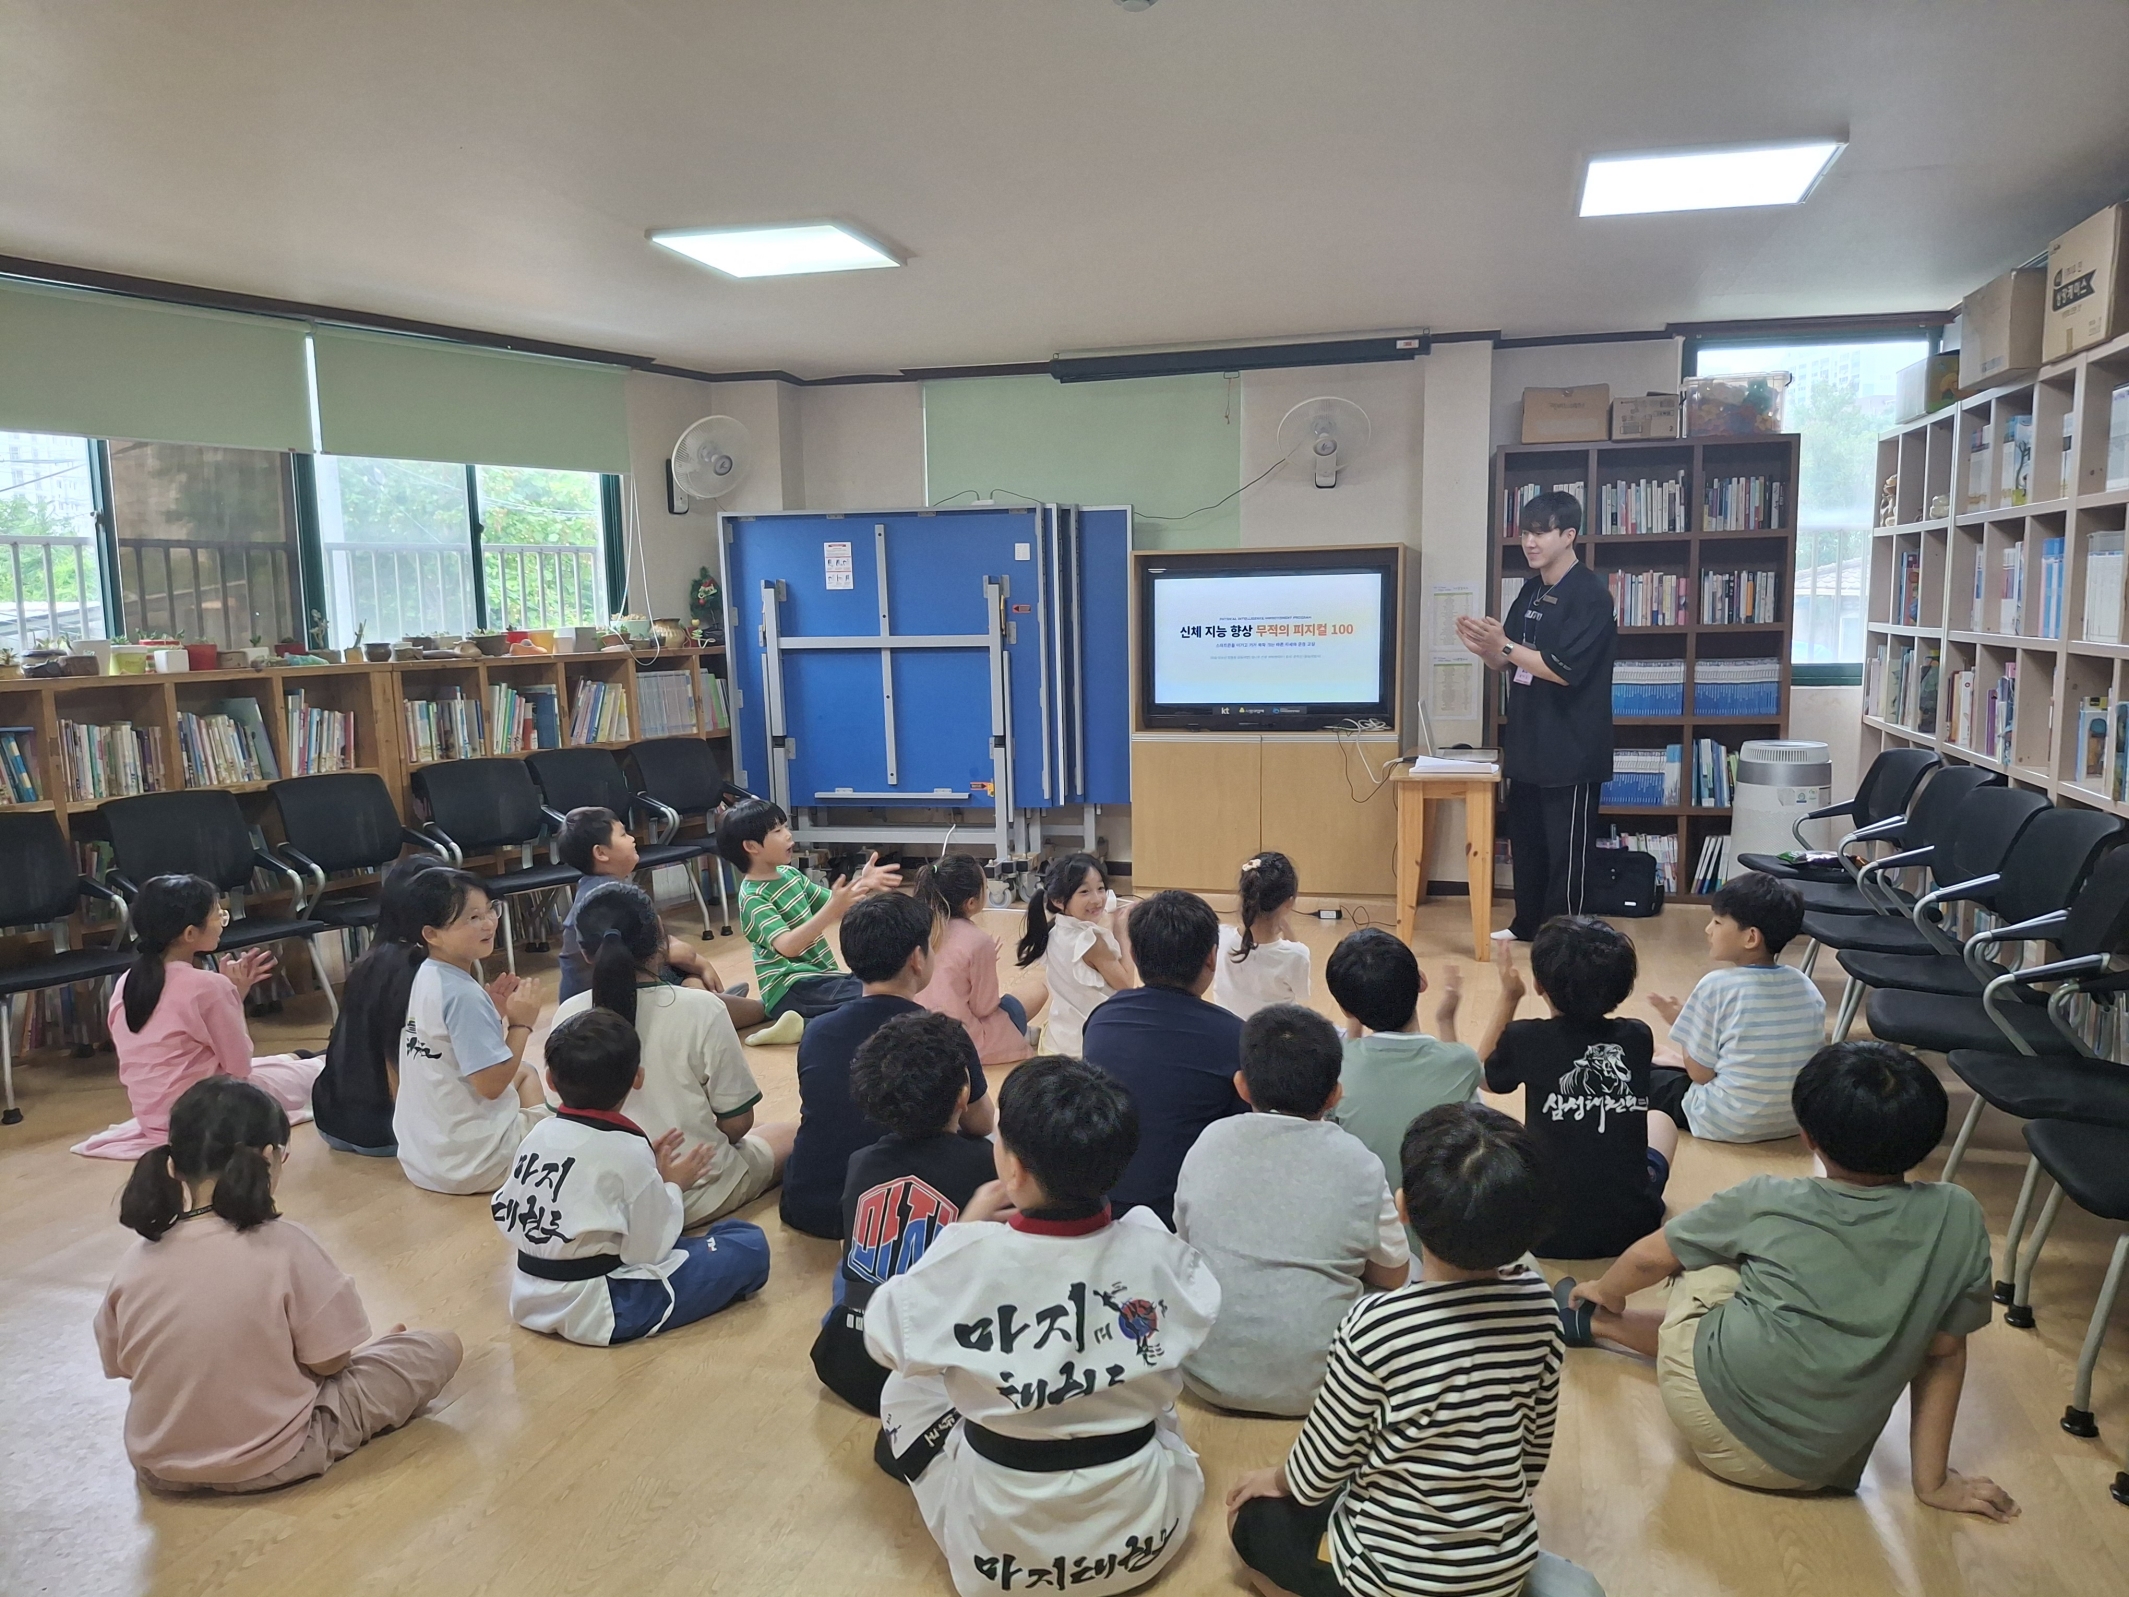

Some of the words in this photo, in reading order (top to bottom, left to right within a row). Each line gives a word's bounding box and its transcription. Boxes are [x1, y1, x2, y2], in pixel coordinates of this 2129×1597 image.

[1180, 625, 1202, 639] 신체
[1205, 625, 1227, 638] 지능
[1230, 624, 1253, 638] 향상
[1256, 624, 1289, 637] 무적의
[1293, 623, 1328, 637] 피지컬
[1331, 624, 1354, 635] 100
[1221, 707, 1230, 715] kt
[514, 1152, 576, 1203] 마지
[954, 1281, 1086, 1355] 마지
